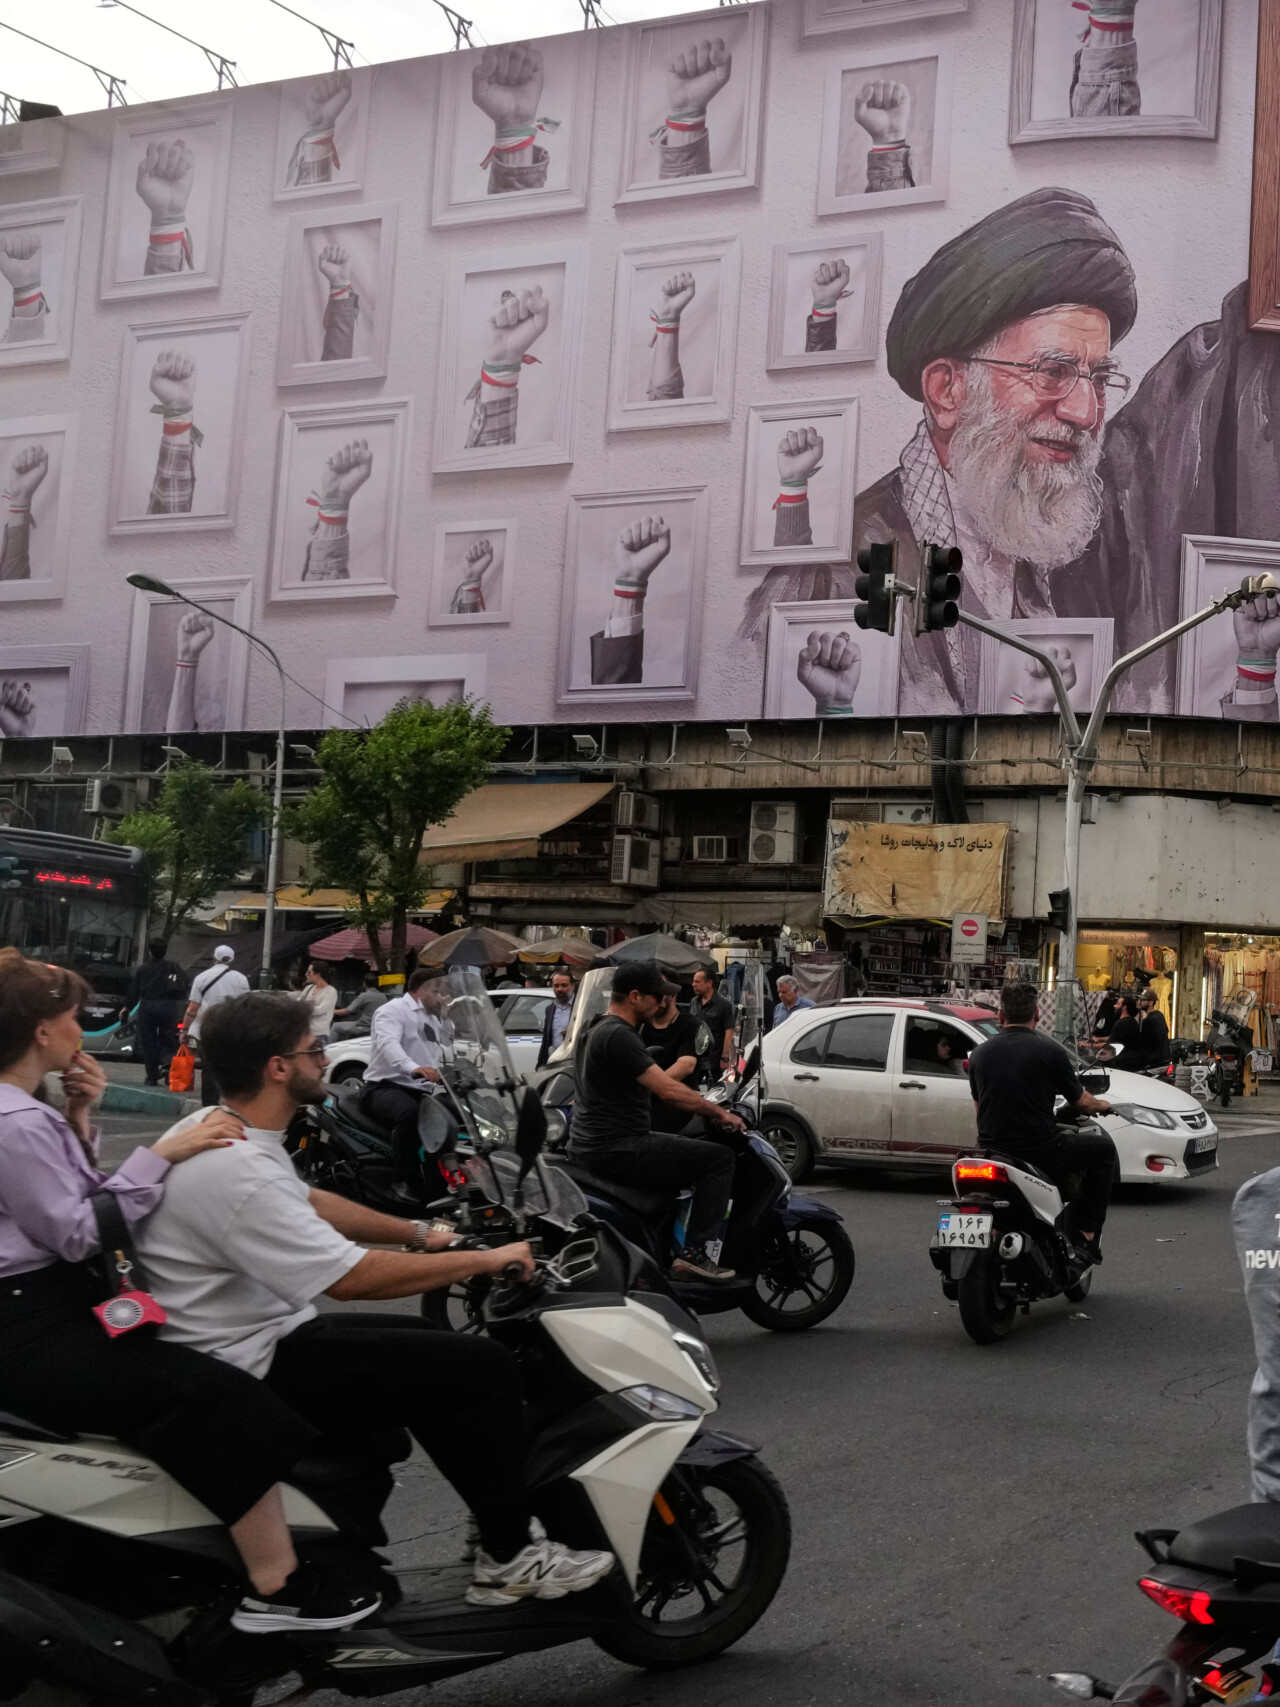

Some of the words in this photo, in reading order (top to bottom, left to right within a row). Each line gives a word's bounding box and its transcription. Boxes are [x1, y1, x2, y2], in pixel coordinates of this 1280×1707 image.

[880, 834, 899, 851] روشا
[947, 837, 965, 848] لاک
[966, 839, 993, 852] دنیای
[941, 1232, 986, 1246] ۱۶۹۵۹
